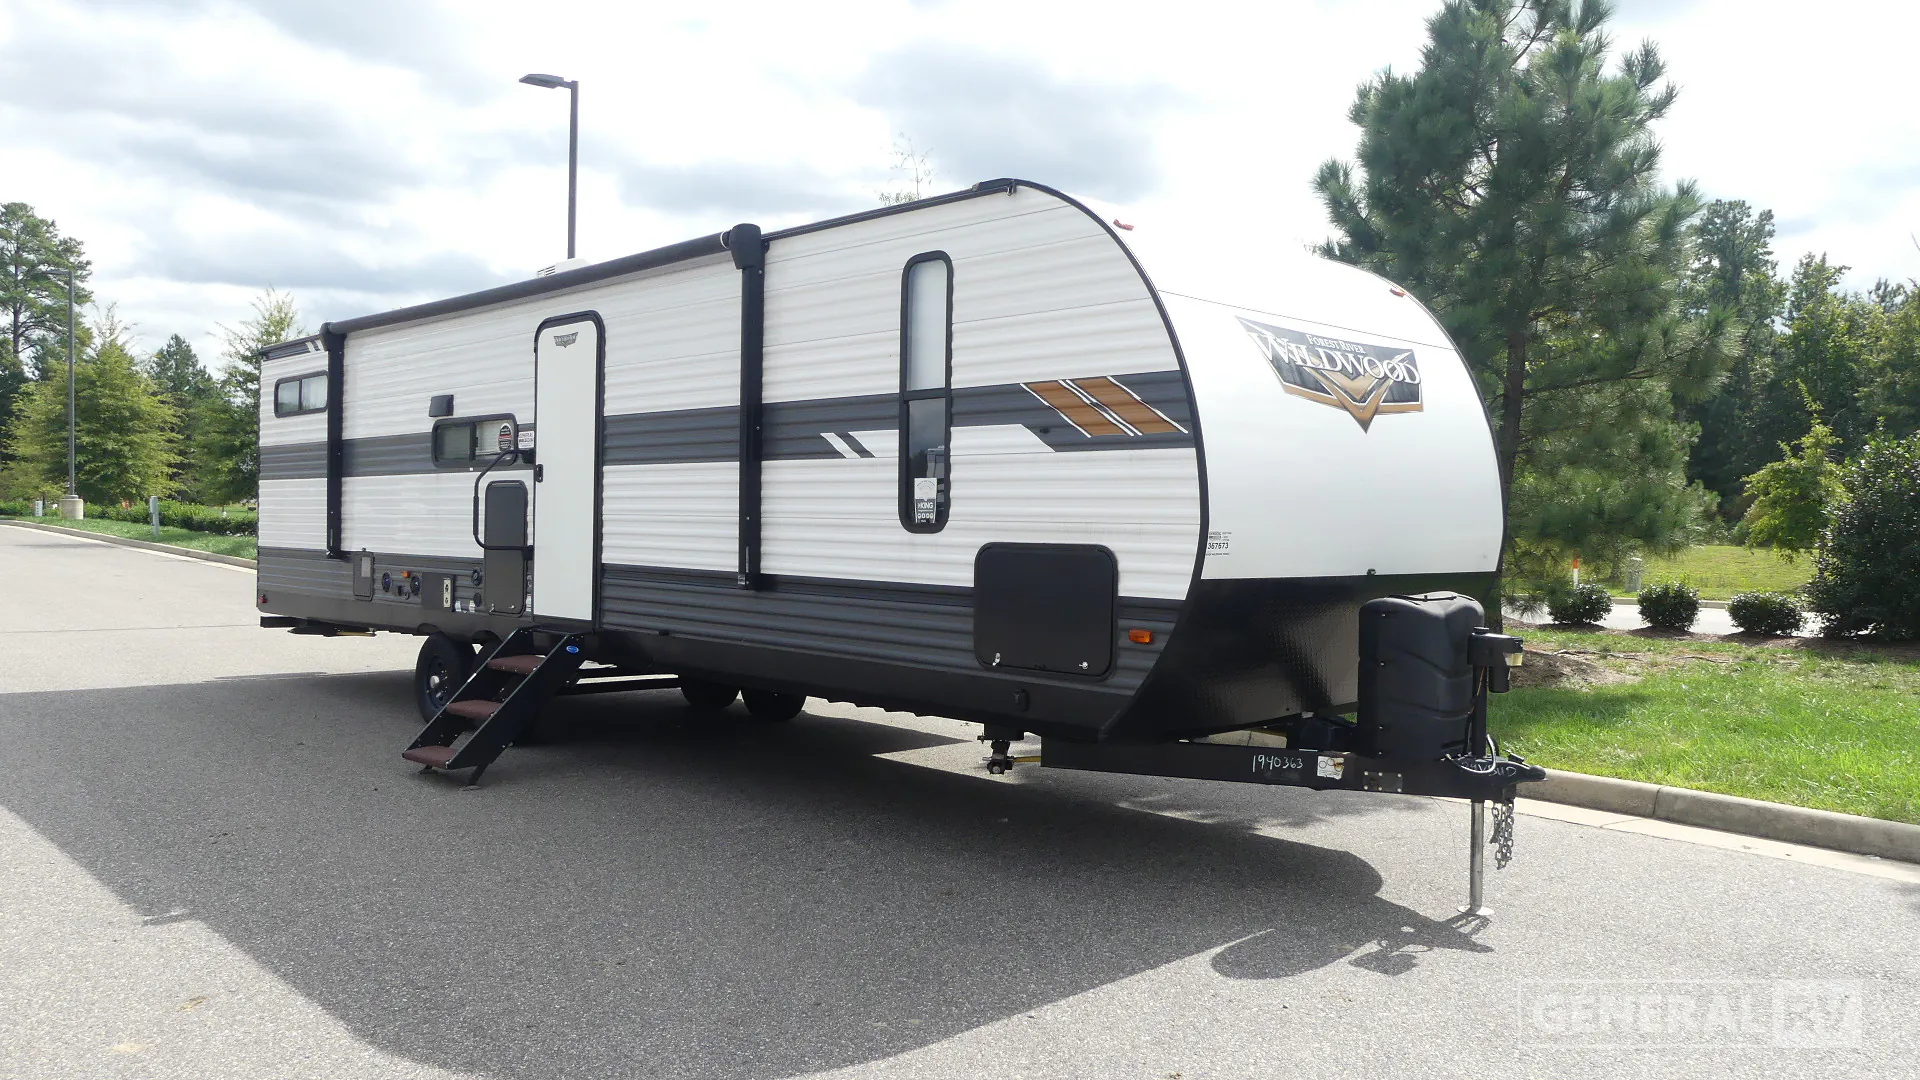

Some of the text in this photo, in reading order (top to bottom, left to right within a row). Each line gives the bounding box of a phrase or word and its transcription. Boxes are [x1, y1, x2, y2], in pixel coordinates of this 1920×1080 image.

[1306, 334, 1367, 354] FOREST RIVER
[1247, 332, 1421, 385] WILDWOOD
[1252, 754, 1303, 773] 1940363
